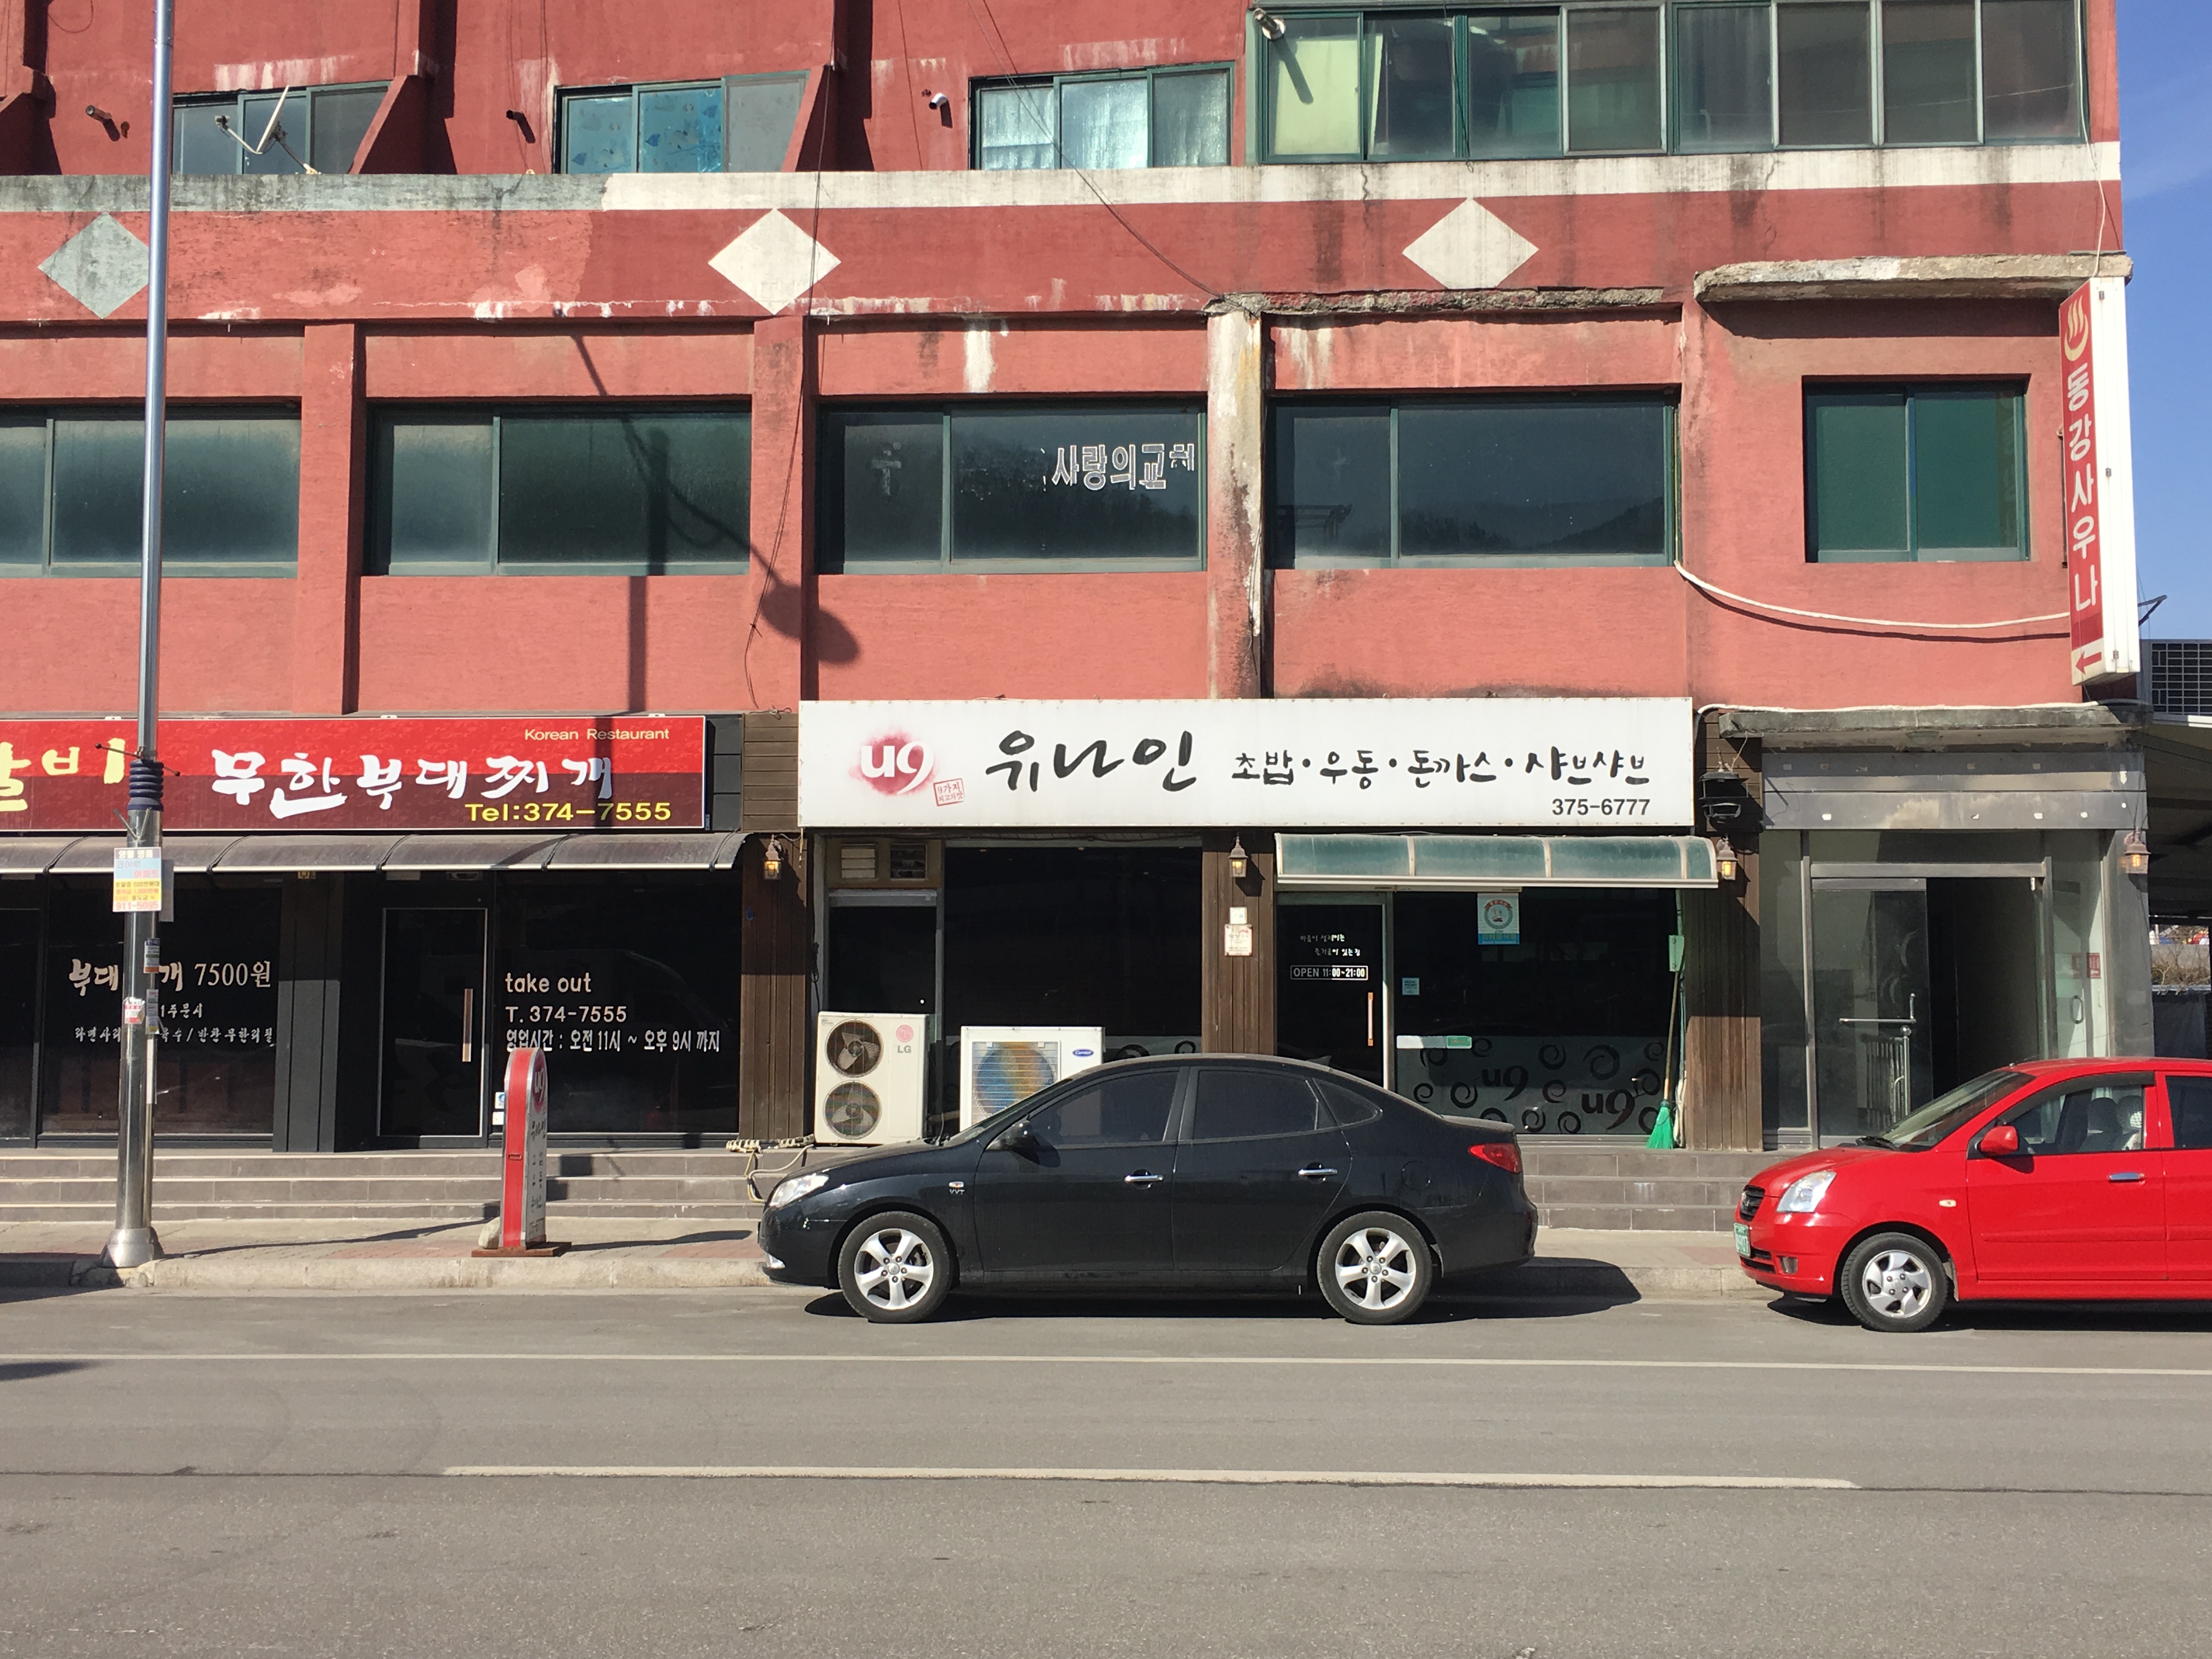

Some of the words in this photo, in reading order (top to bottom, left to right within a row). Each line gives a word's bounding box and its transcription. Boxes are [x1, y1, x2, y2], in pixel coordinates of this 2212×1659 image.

[2067, 363, 2098, 611] 동강사우나
[524, 729, 579, 740] Korean
[586, 729, 670, 740] Restaurant
[986, 731, 1197, 792] 유나인
[1553, 799, 1650, 815] 375-6777
[116, 901, 159, 911] 911-5095
[194, 961, 270, 987] 7500원
[1293, 967, 1319, 977] OPEN
[505, 972, 549, 992] take
[557, 972, 591, 992] out
[529, 1006, 627, 1023] 374-7555
[570, 1029, 593, 1052] 오전
[598, 1030, 621, 1052] 11시
[644, 1029, 667, 1052] 오후
[673, 1030, 691, 1052] 9시
[696, 1030, 720, 1052] 까지
[898, 1045, 911, 1053] LG
